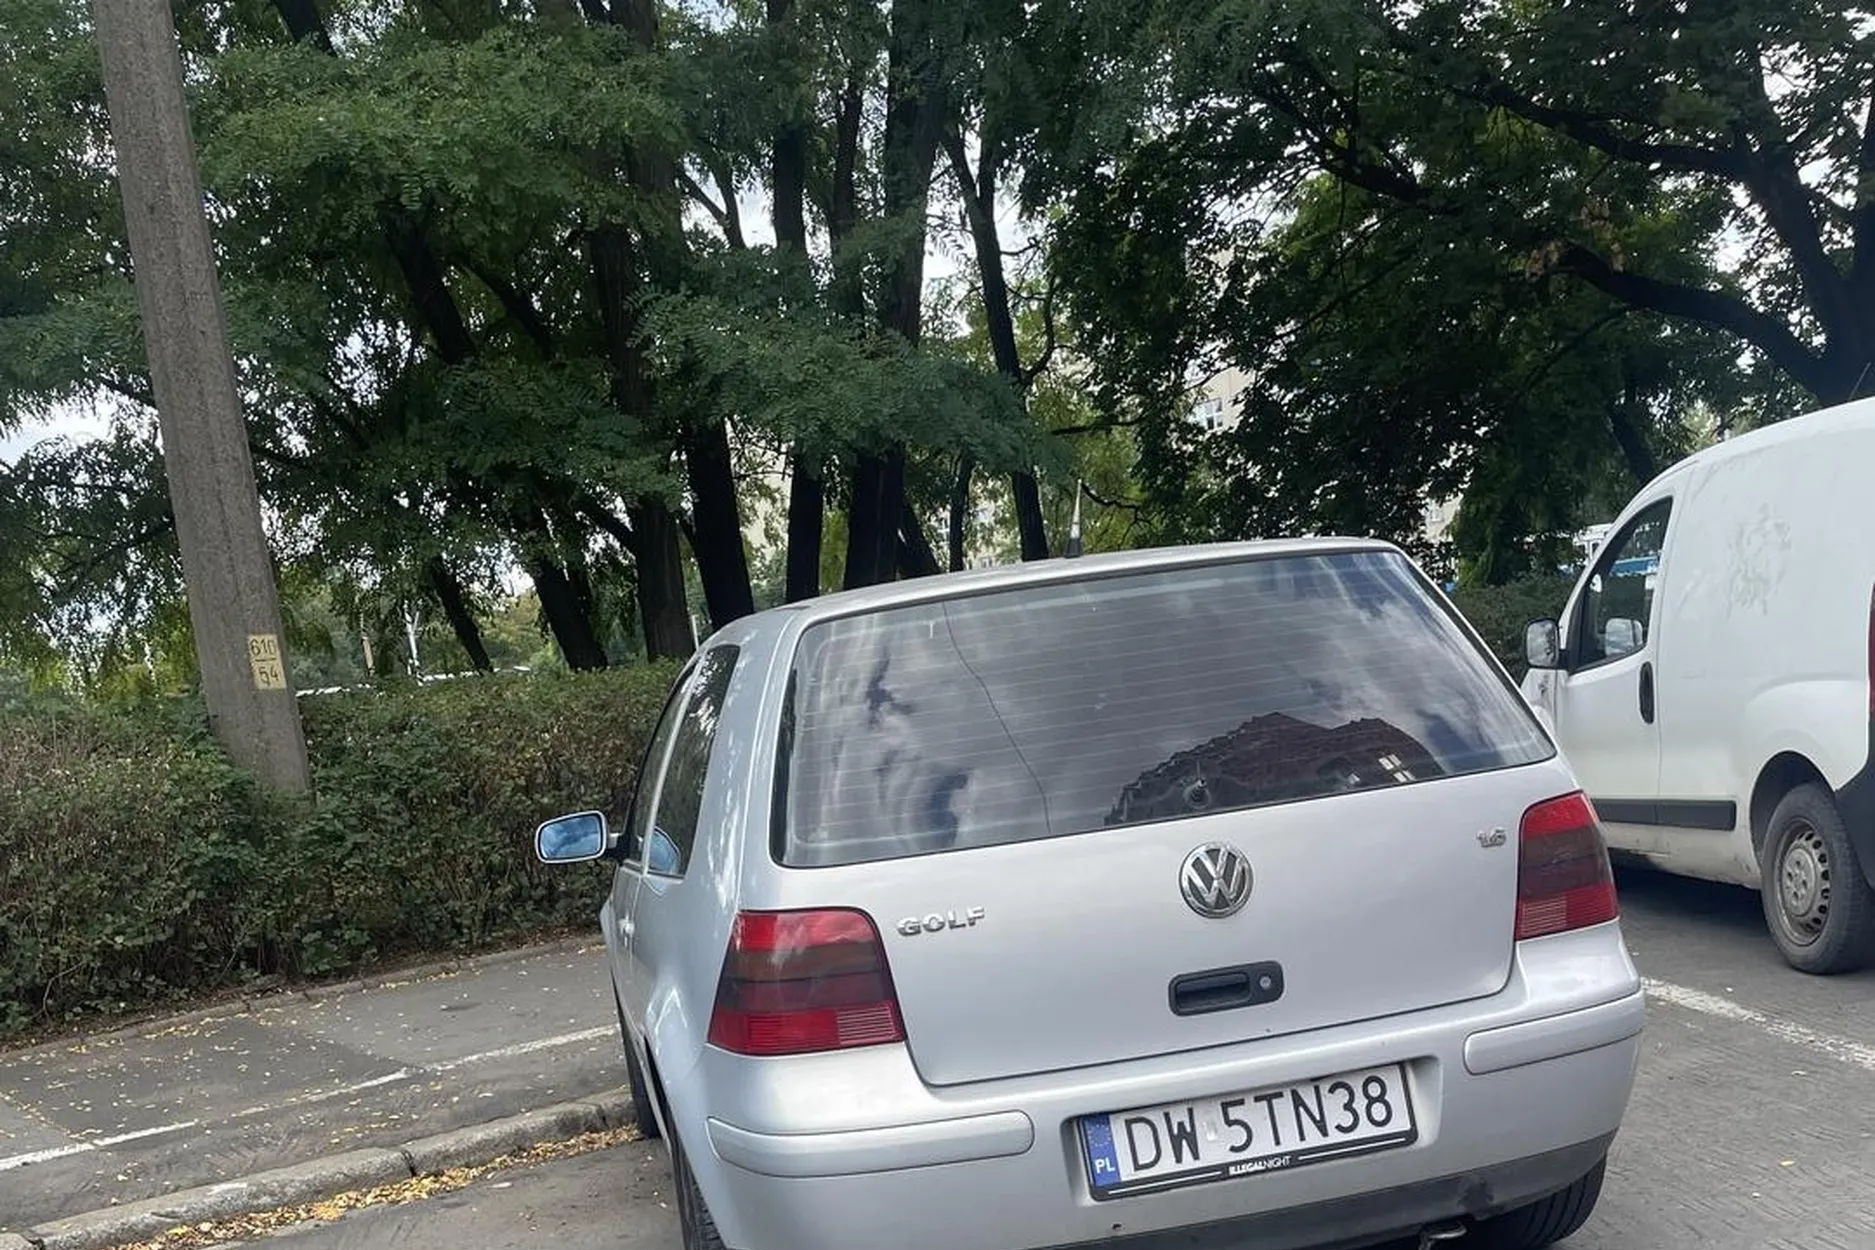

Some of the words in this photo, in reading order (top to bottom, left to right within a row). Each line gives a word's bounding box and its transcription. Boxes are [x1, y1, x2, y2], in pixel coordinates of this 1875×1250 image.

[250, 638, 277, 656] 610
[258, 664, 280, 686] 54
[898, 906, 985, 936] GOLF
[1124, 1107, 1200, 1172] DW
[1220, 1074, 1394, 1153] 5TN38
[1095, 1157, 1116, 1174] PL
